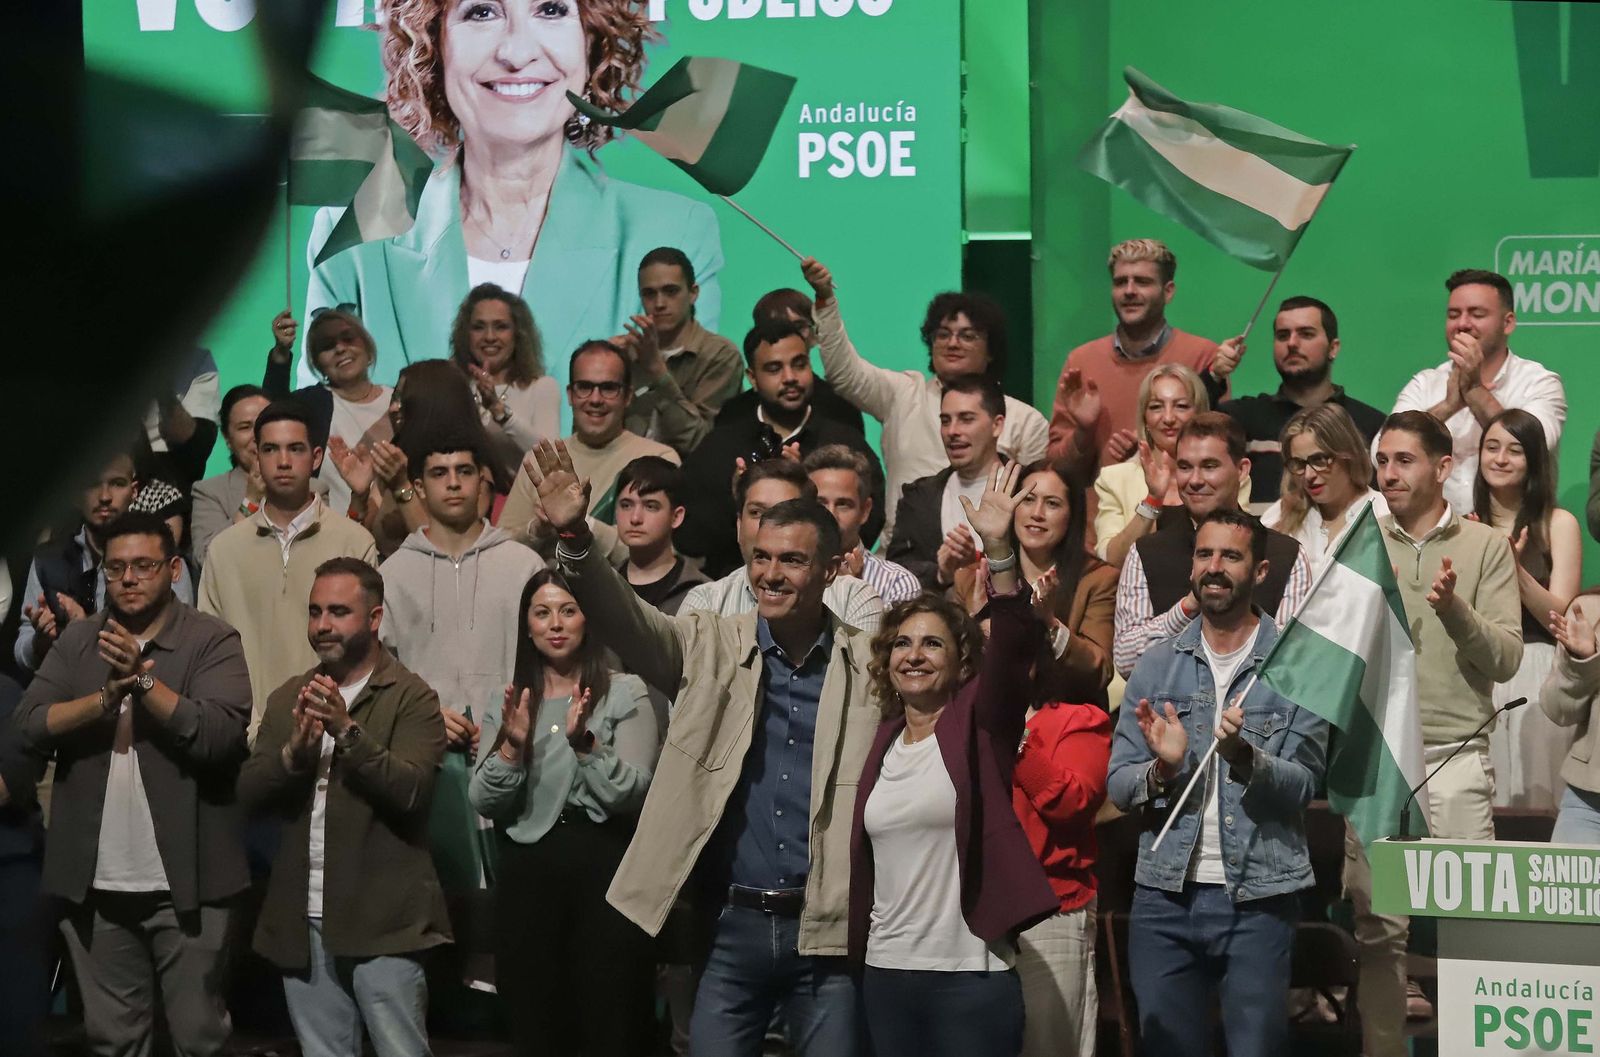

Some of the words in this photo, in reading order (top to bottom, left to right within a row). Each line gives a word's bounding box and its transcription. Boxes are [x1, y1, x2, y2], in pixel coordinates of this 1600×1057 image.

[799, 100, 916, 123] Andalucía
[798, 130, 916, 178] PSOE
[1508, 242, 1600, 275] MARÍA
[1513, 281, 1600, 314] MON
[1404, 849, 1520, 913] VOTA
[1475, 976, 1593, 1001] Andalucía
[1474, 1004, 1593, 1054] PSOE
